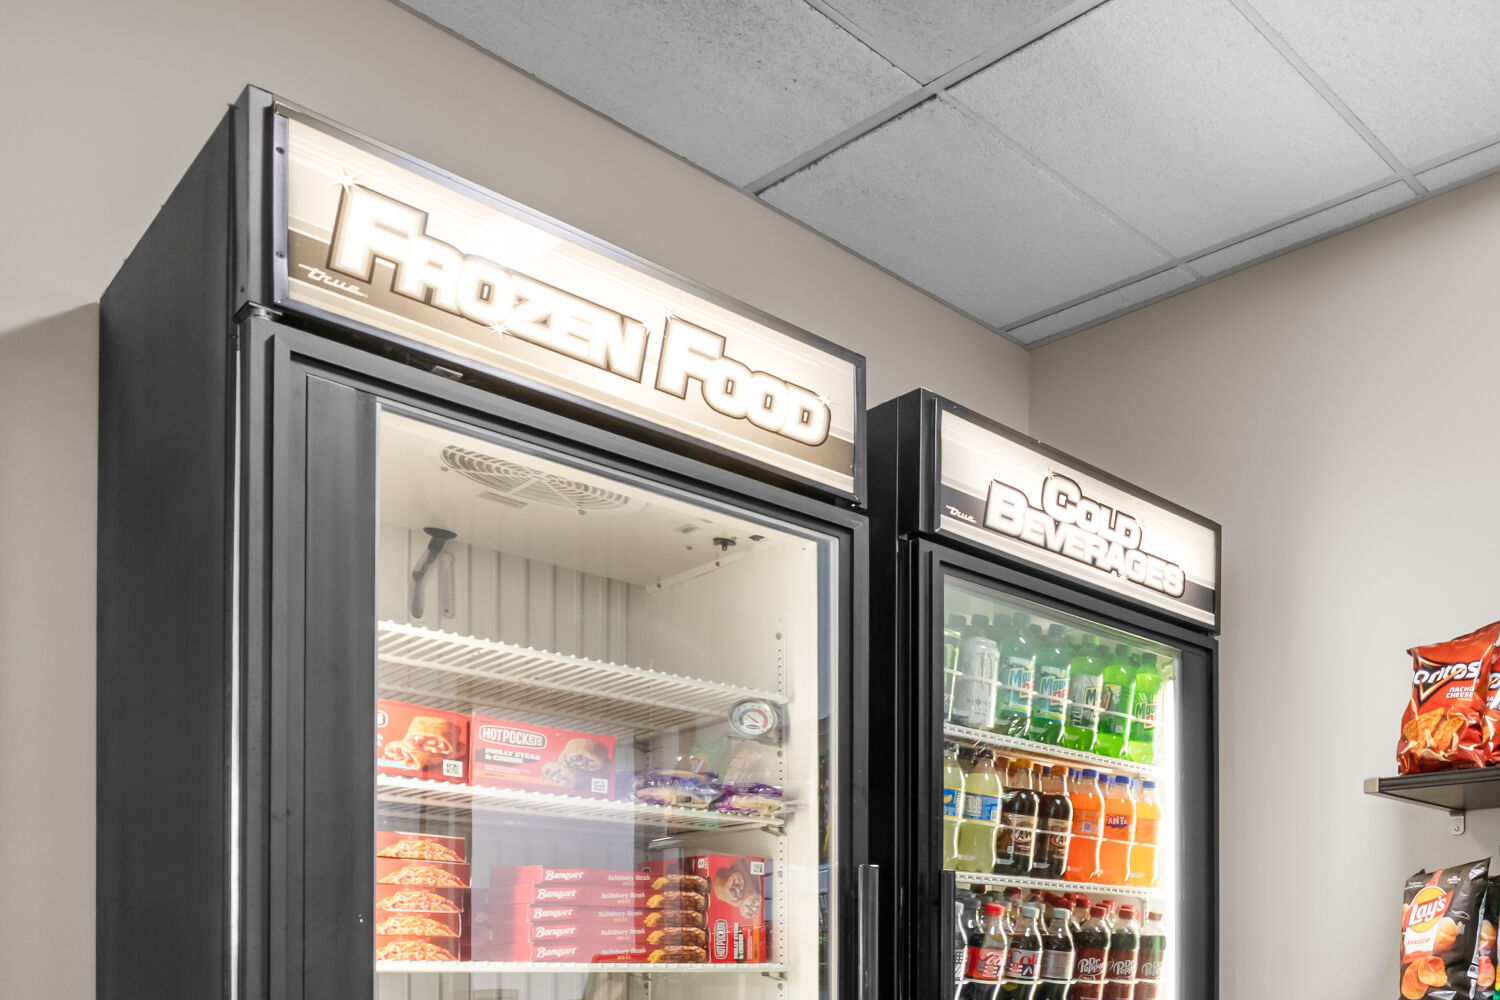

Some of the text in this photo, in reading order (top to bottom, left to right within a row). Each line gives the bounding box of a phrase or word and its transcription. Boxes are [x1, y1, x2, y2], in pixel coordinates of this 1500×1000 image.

[327, 186, 832, 447] FROZEN FOOD
[1041, 472, 1142, 550] COLD
[983, 480, 1185, 598] BEVERAGES
[1413, 661, 1482, 685] oritos
[545, 870, 584, 880] Banquet
[537, 888, 577, 900] Banquet
[533, 907, 574, 919] Banquet
[1408, 896, 1447, 926] Lay's
[535, 926, 576, 938] Banquet
[536, 947, 577, 958] Banquet
